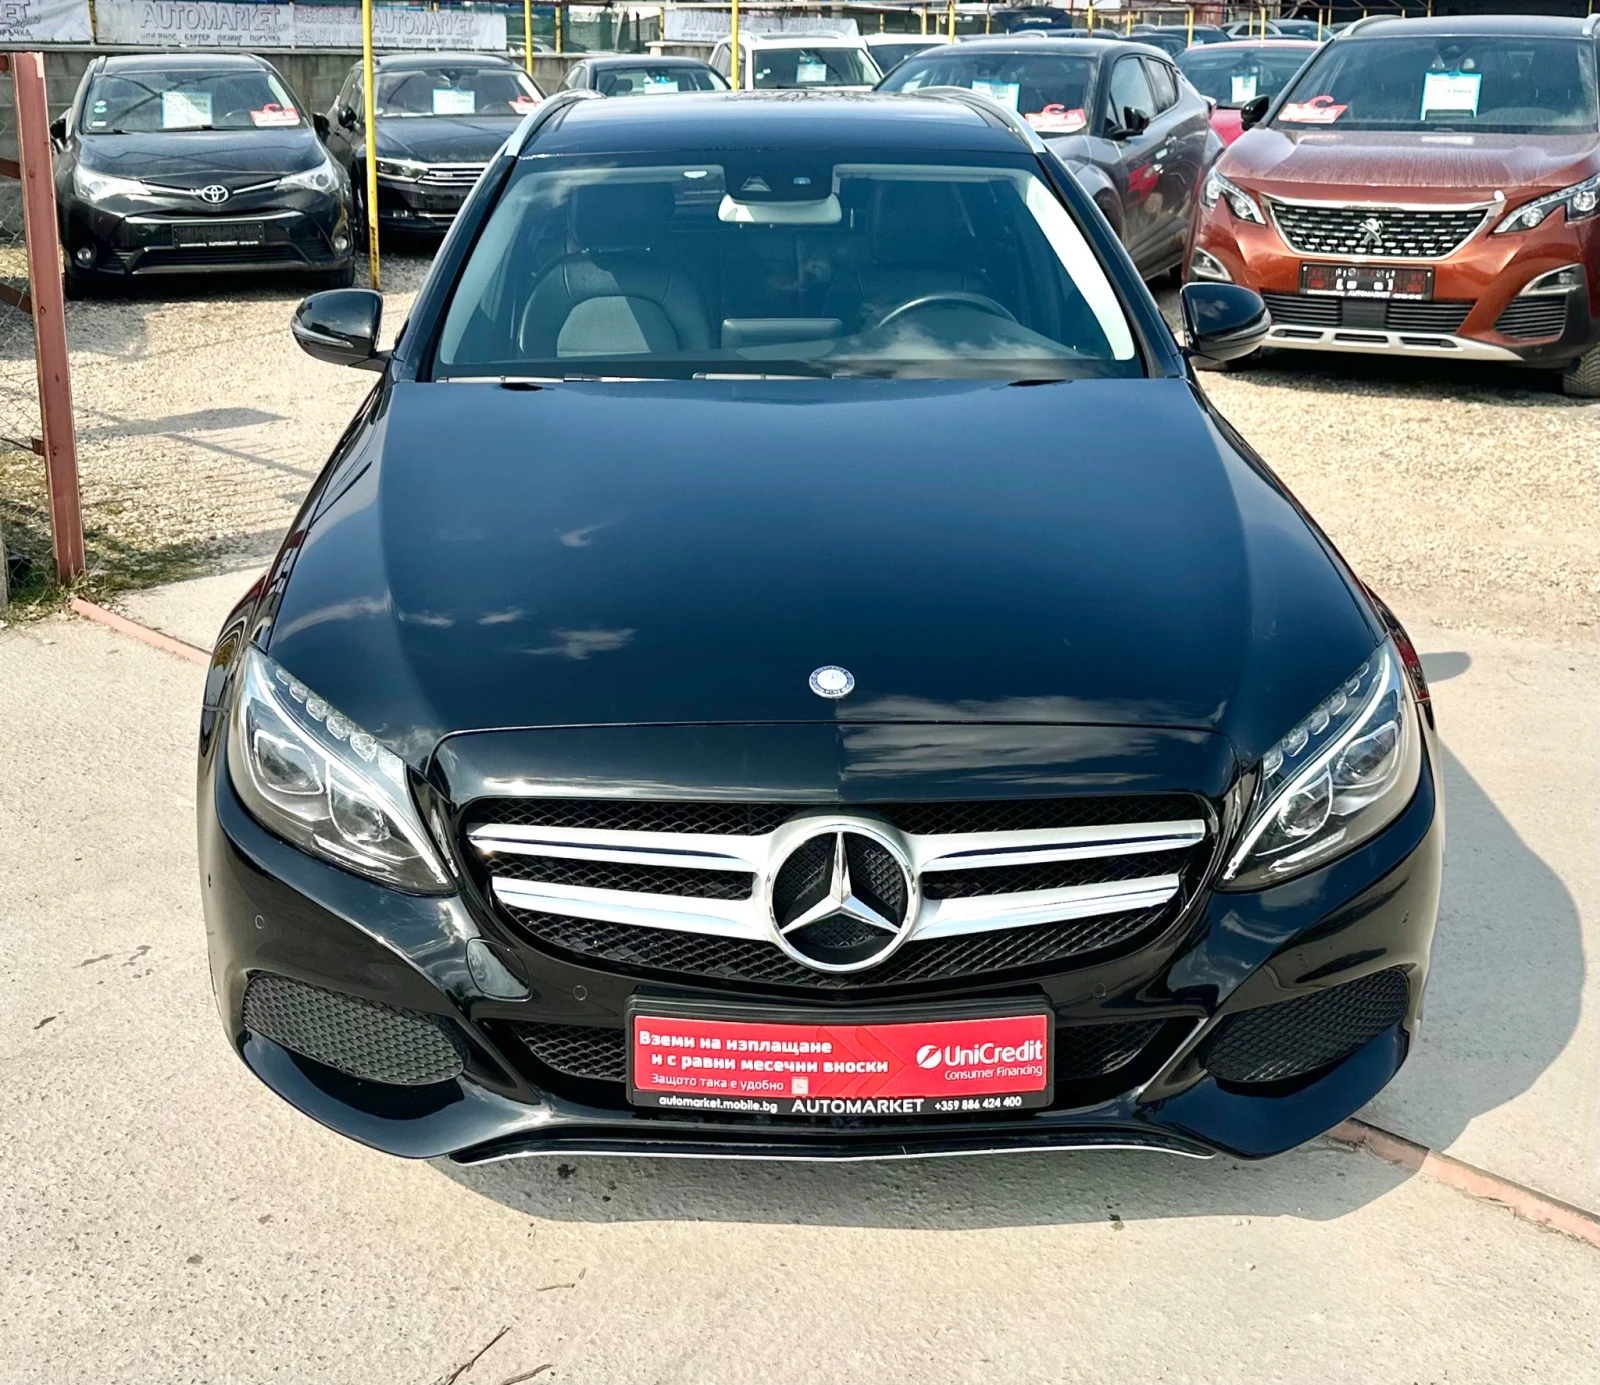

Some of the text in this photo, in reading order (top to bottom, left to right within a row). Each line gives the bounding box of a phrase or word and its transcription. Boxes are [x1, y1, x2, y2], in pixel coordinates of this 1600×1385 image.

[139, 2, 281, 32] AUTOMARKET
[372, 10, 474, 35] AUTOMARKET
[639, 1031, 833, 1055] Вземи на изплащане
[945, 1040, 1043, 1066] UniCredit
[651, 1053, 888, 1073] и с равни месечни вноски
[945, 1065, 1043, 1081] Consumer Financing
[652, 1074, 785, 1092] Защото така е удобно
[659, 1095, 1022, 1114] automarket.mobile.bg AUTOMARKET +359 886 424 400
